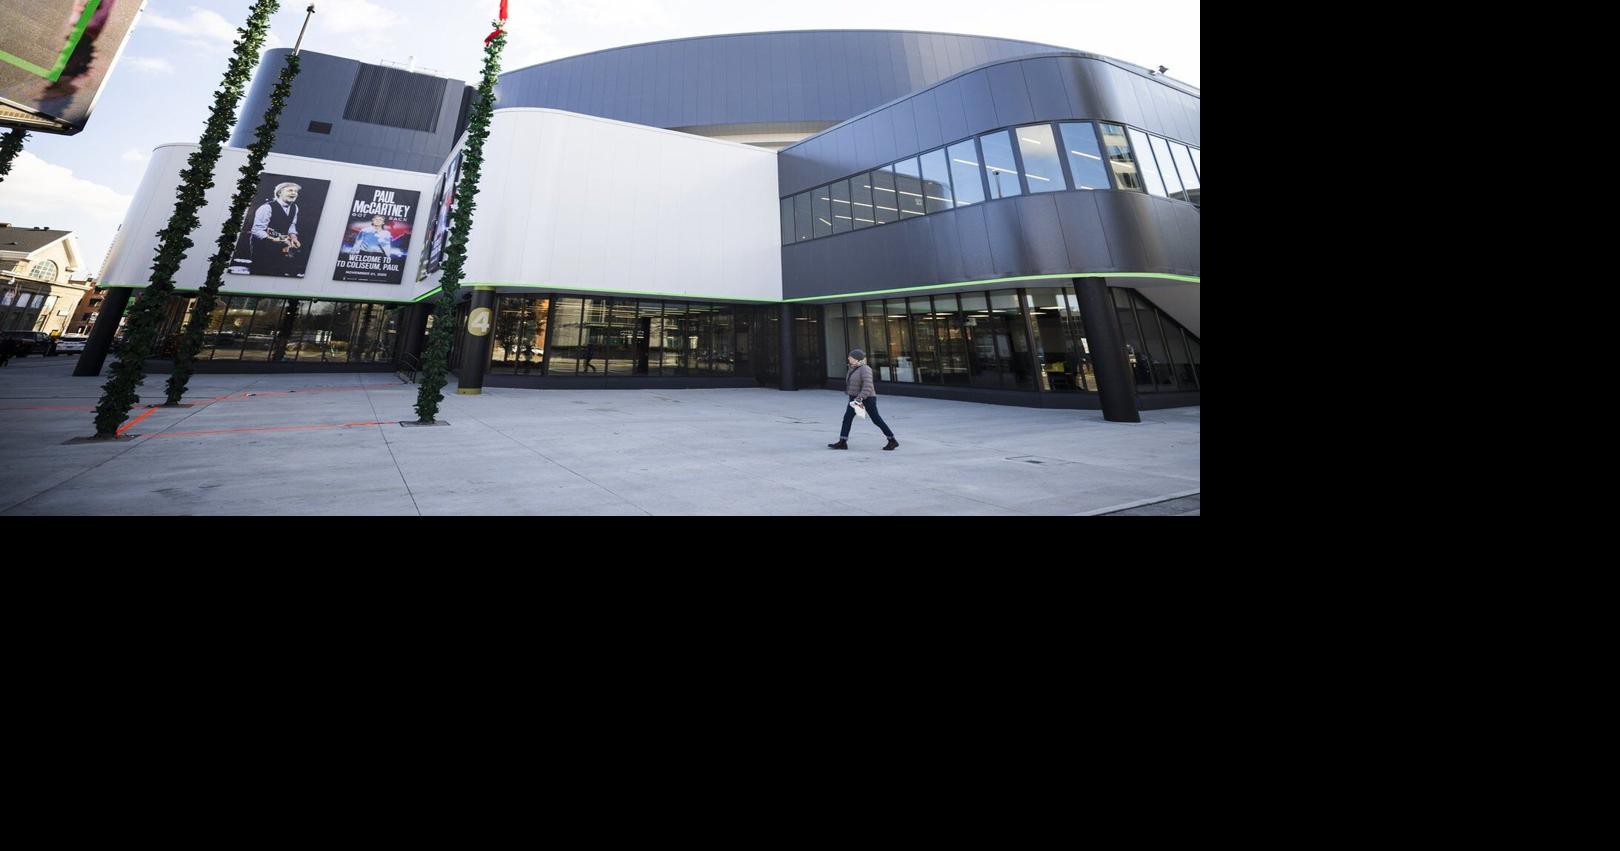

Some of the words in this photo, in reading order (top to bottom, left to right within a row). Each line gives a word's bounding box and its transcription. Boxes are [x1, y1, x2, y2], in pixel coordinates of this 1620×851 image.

[373, 190, 395, 204] PAUL
[353, 200, 410, 217] McCARTNEY
[349, 255, 381, 263] WELCOME
[347, 261, 381, 270] COLISEUM,
[383, 263, 399, 272] PAUL
[469, 311, 490, 333] 4
